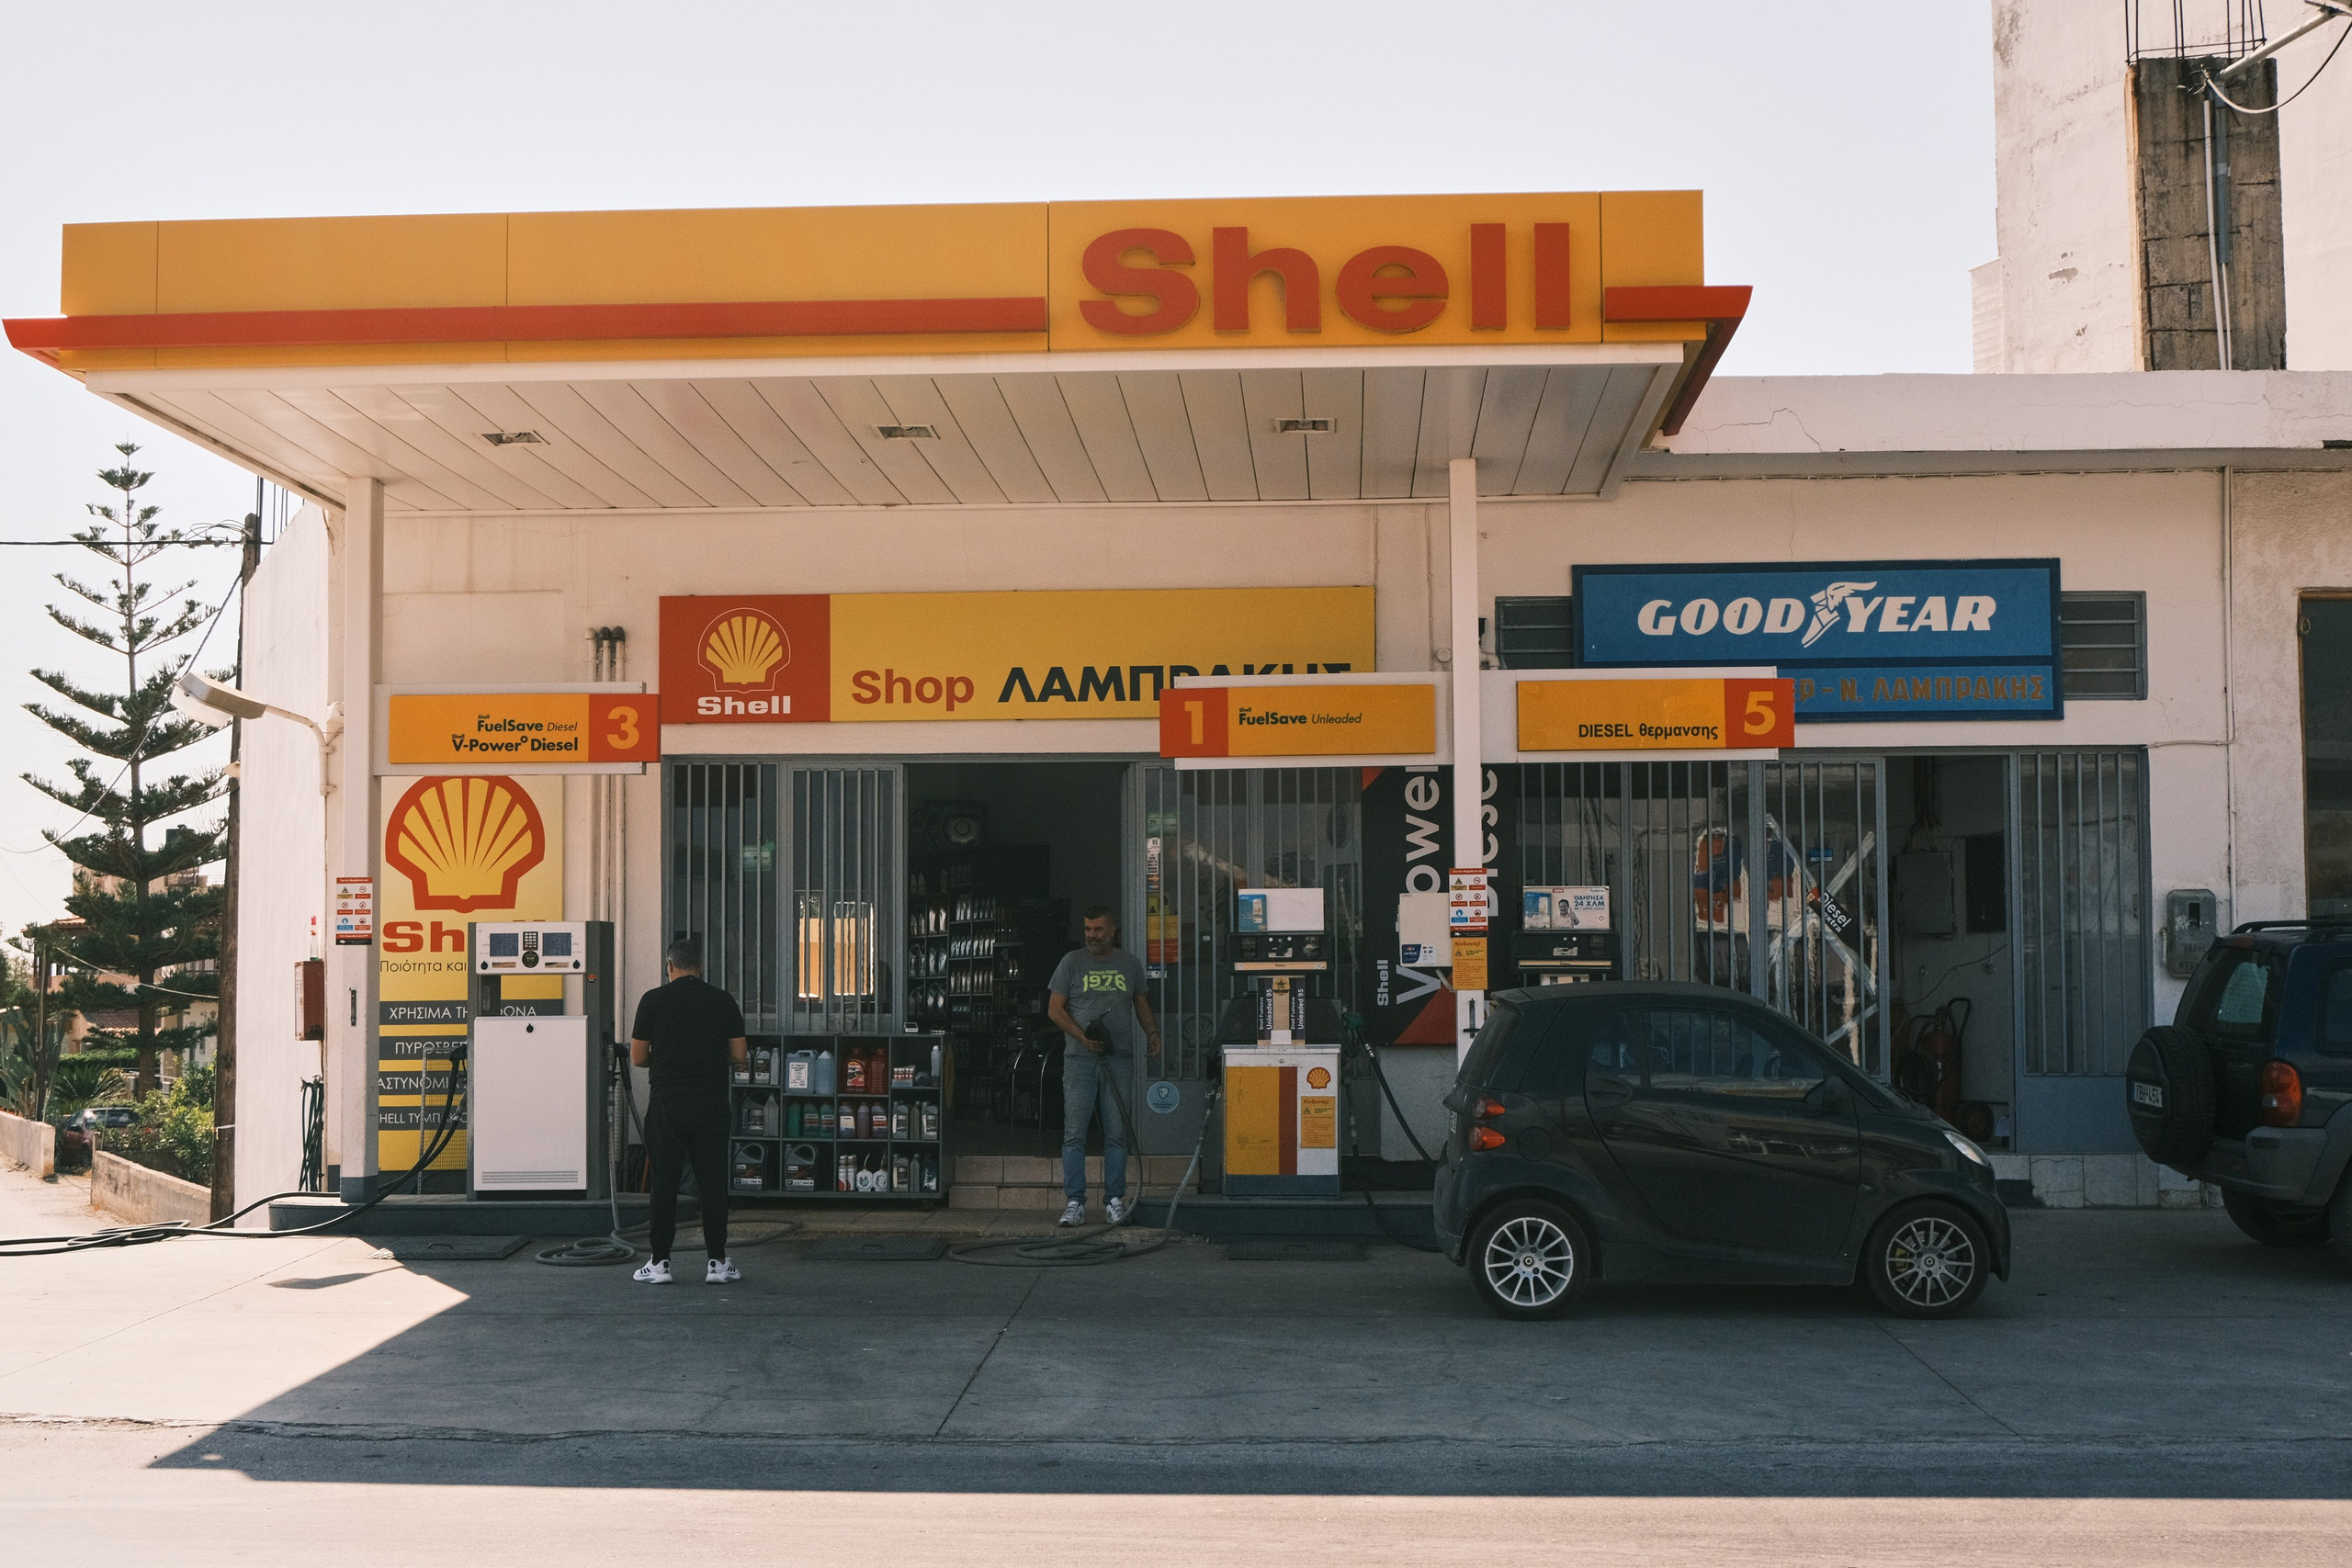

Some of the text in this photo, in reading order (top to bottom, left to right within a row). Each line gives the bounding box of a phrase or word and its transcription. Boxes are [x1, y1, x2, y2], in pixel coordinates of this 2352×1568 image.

[1079, 222, 1571, 336] Shell
[852, 669, 975, 712] Shop
[1872, 676, 2045, 702] ΛΑΜΠΡΑΚΗΣ
[697, 695, 791, 715] Shell
[1744, 691, 1776, 736] 5
[477, 718, 578, 732] FuelSave Diesel
[1184, 701, 1203, 745] 1
[1239, 712, 1362, 725] FuelSave Unleaded
[606, 706, 639, 750] 3
[1578, 723, 1718, 739] DIESEL θερμανσης
[530, 737, 578, 751] Diesel
[1817, 892, 1852, 928] Diesel
[380, 960, 467, 975] Ποιότητα και
[1082, 974, 1127, 992] 1976
[1376, 959, 1389, 1007] Shell
[1266, 988, 1272, 998] 95
[1297, 988, 1304, 998] 95
[389, 1007, 452, 1020] ΧΡΗΣΙΜΑ
[379, 1113, 405, 1123] HELL
